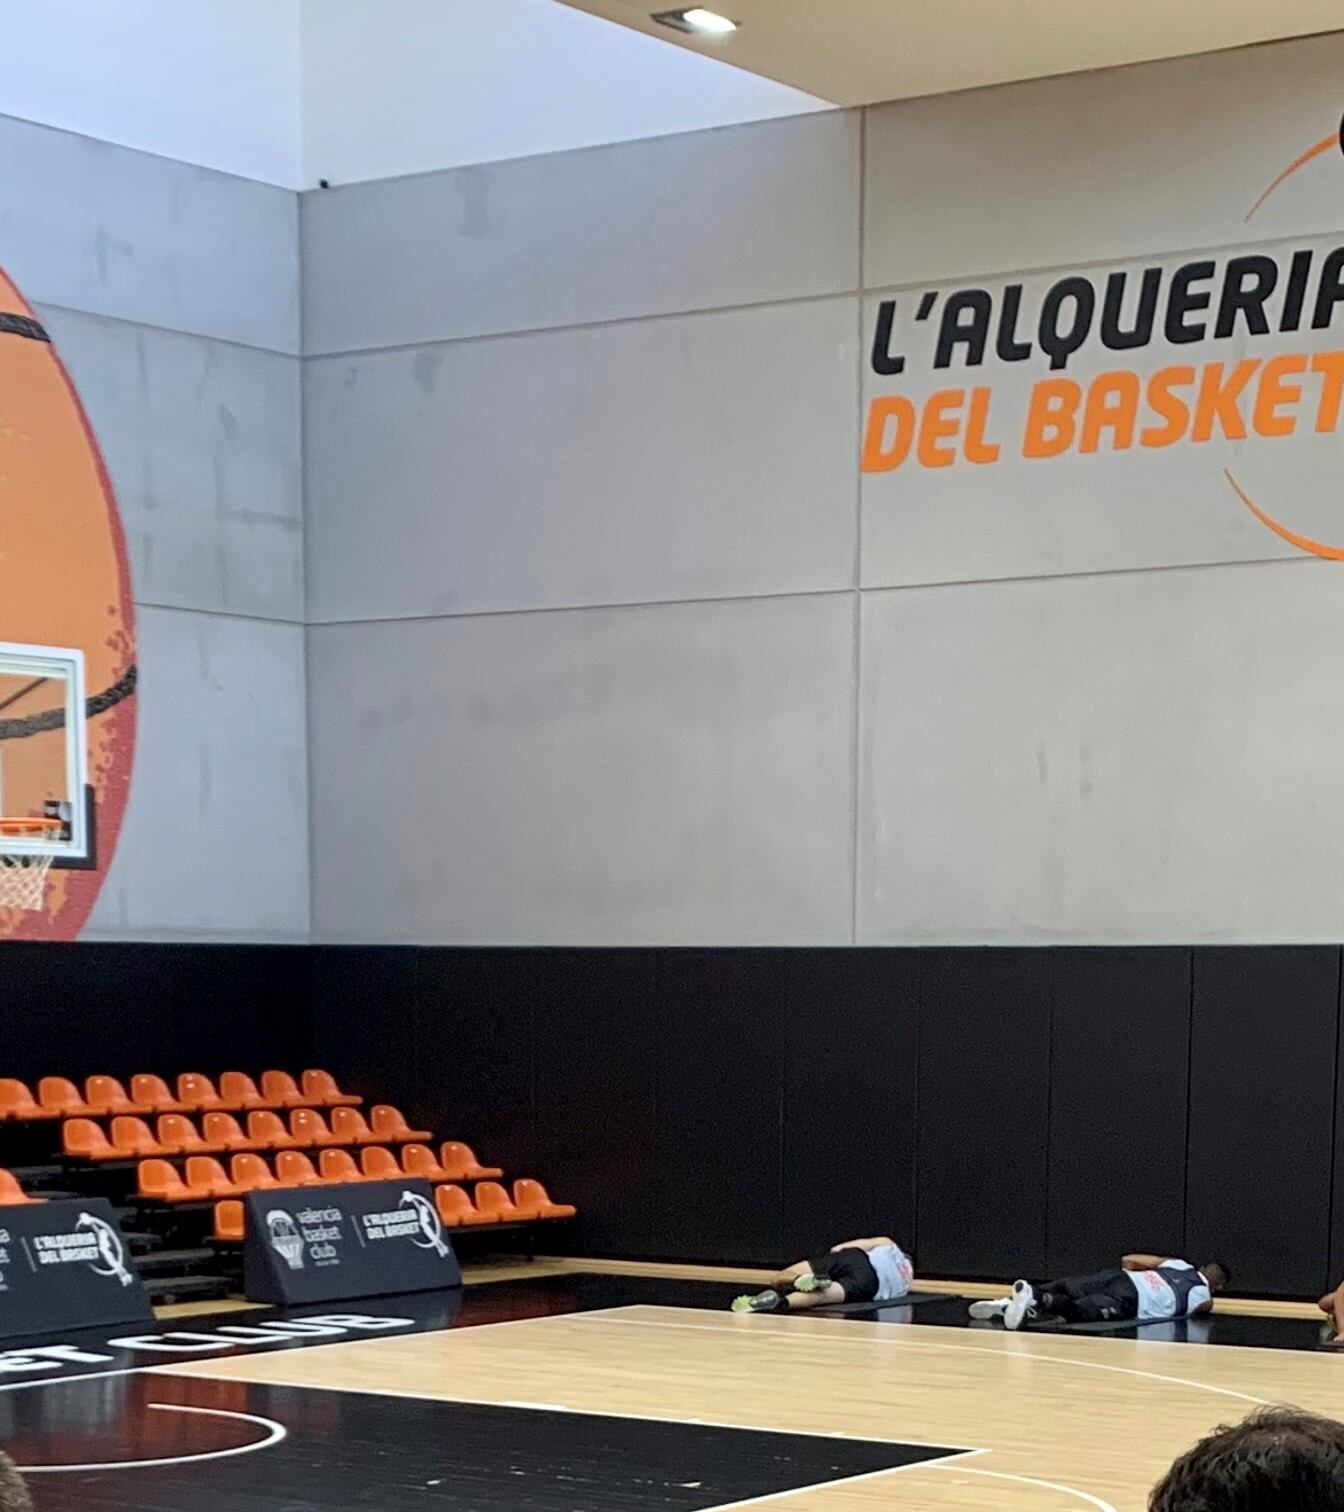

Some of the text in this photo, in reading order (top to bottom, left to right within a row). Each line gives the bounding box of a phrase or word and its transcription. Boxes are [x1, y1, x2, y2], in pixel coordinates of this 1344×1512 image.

[860, 386, 1001, 473] DEL
[38, 1246, 99, 1264] DEL BASKET
[107, 1313, 414, 1352] CLUB
